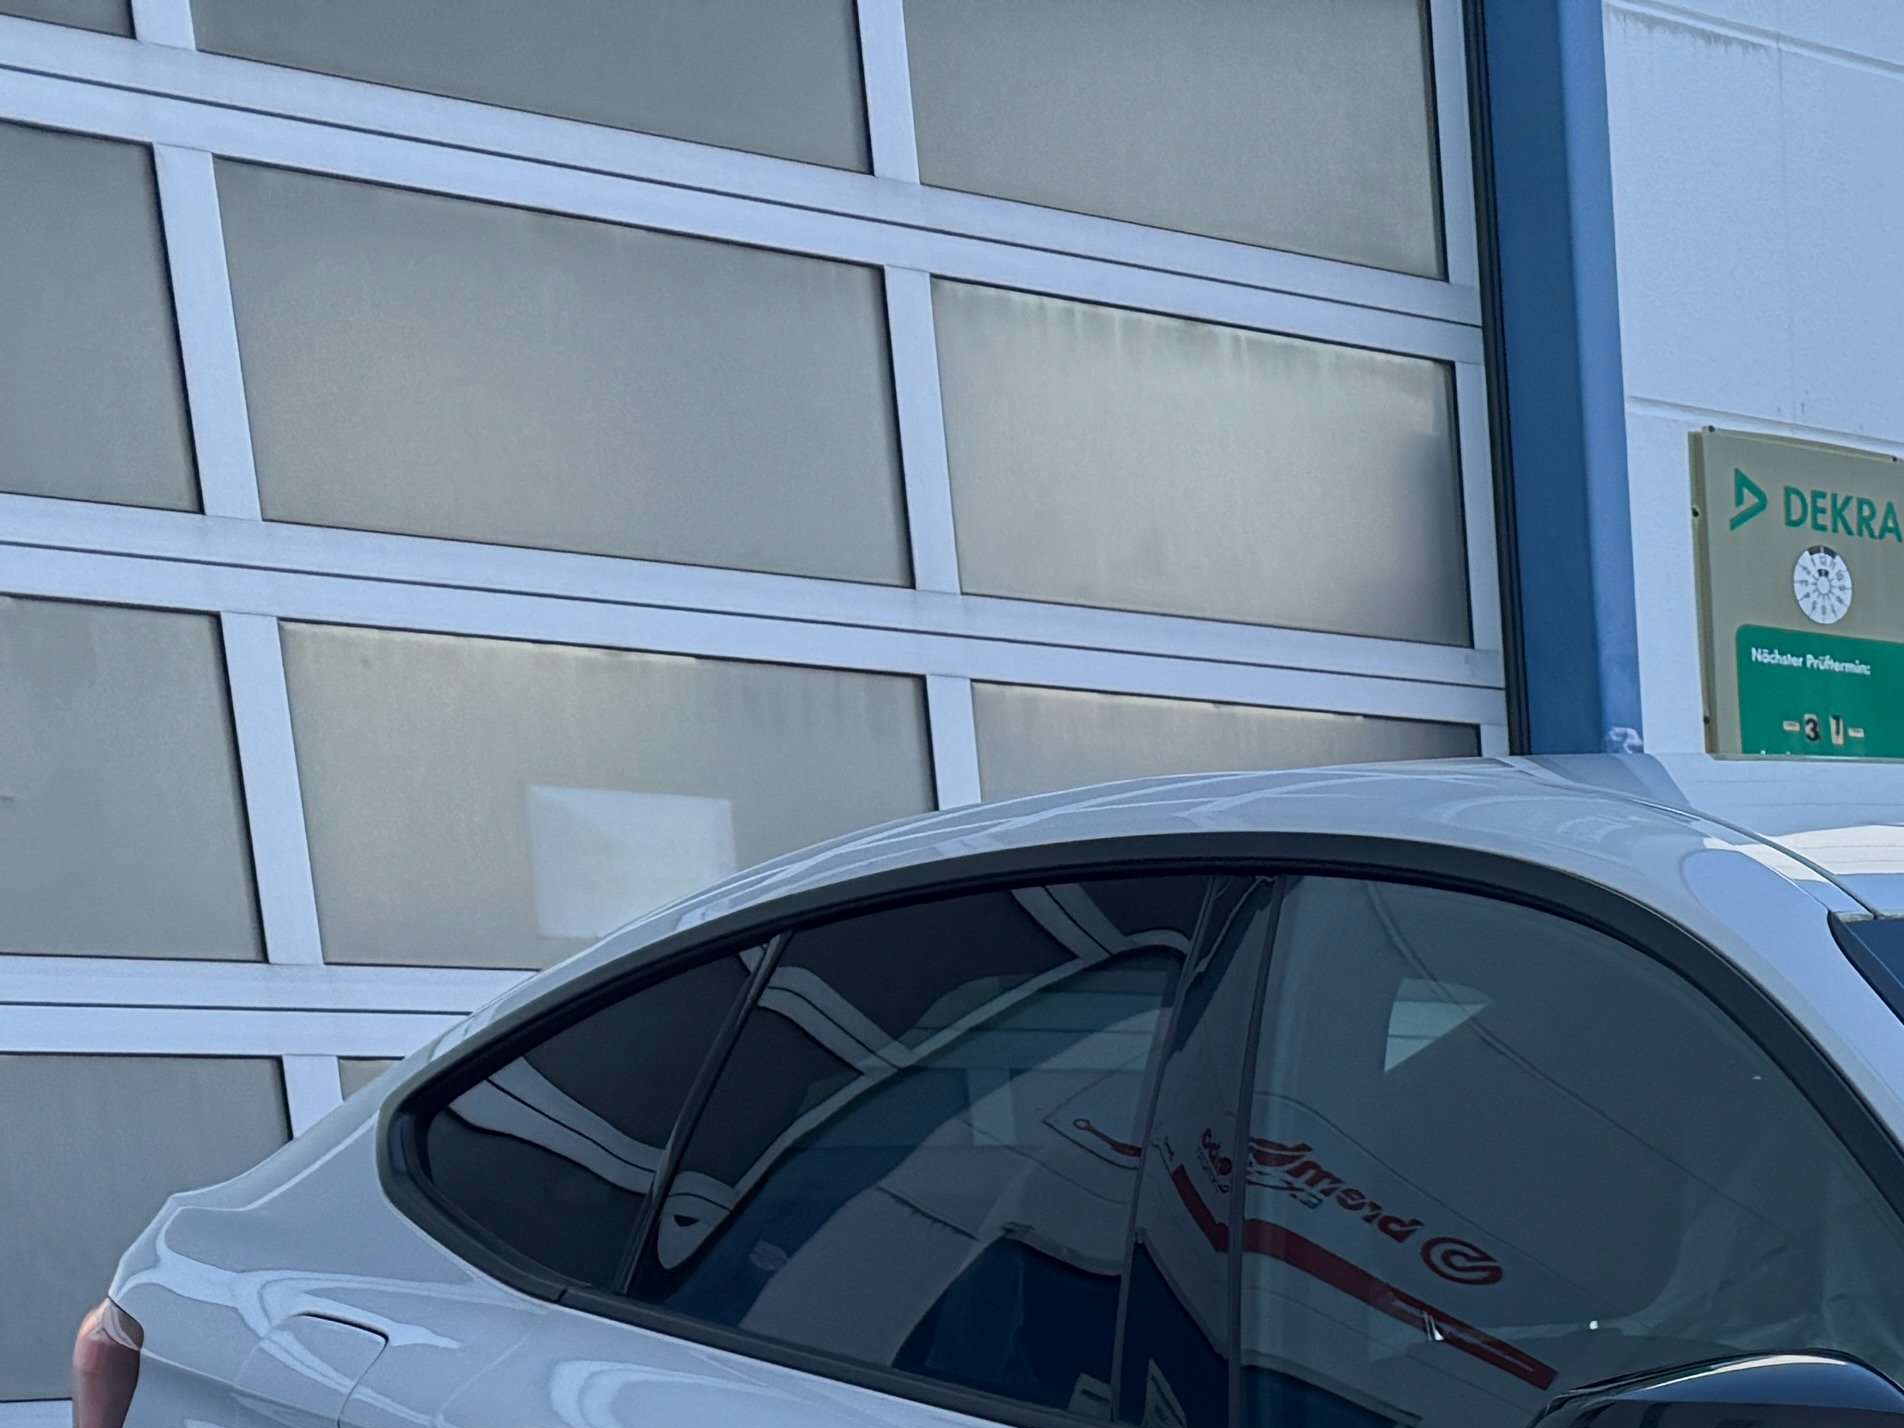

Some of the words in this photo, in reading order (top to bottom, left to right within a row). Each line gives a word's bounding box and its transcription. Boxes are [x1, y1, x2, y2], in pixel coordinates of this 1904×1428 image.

[1783, 485, 1903, 543] DEKRA
[1751, 646, 1803, 669] Nächster
[1806, 653, 1871, 676] Prüftermin:
